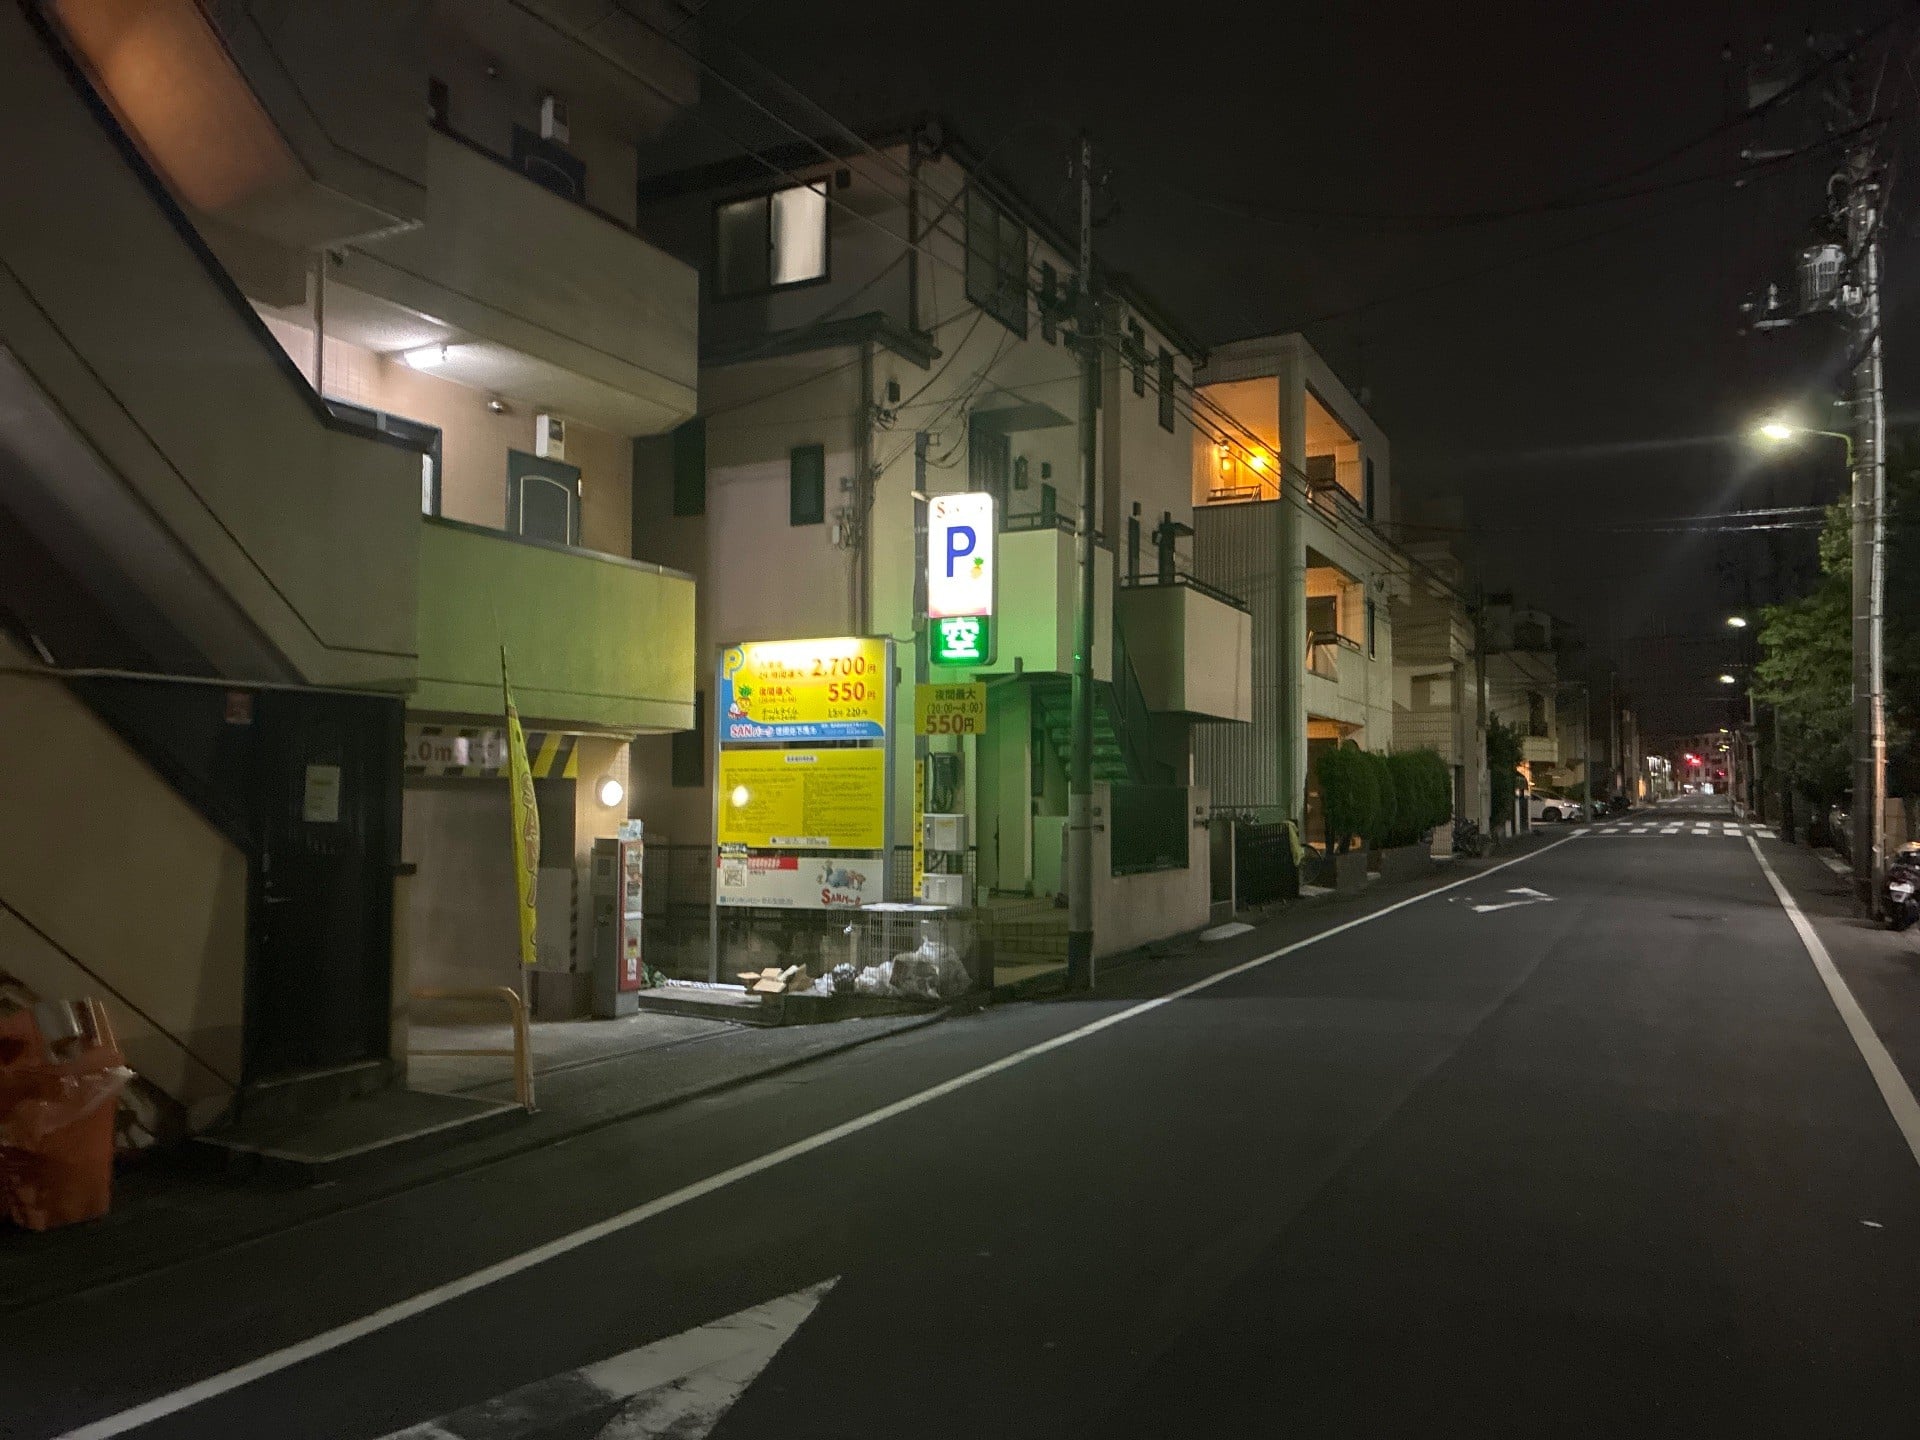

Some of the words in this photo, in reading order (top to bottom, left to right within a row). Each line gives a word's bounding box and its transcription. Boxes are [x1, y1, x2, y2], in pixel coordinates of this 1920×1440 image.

[946, 525, 977, 578] P
[941, 617, 980, 658] 空
[828, 681, 876, 702] 550円
[935, 688, 977, 700] 夜間最大
[926, 714, 975, 734] 550円
